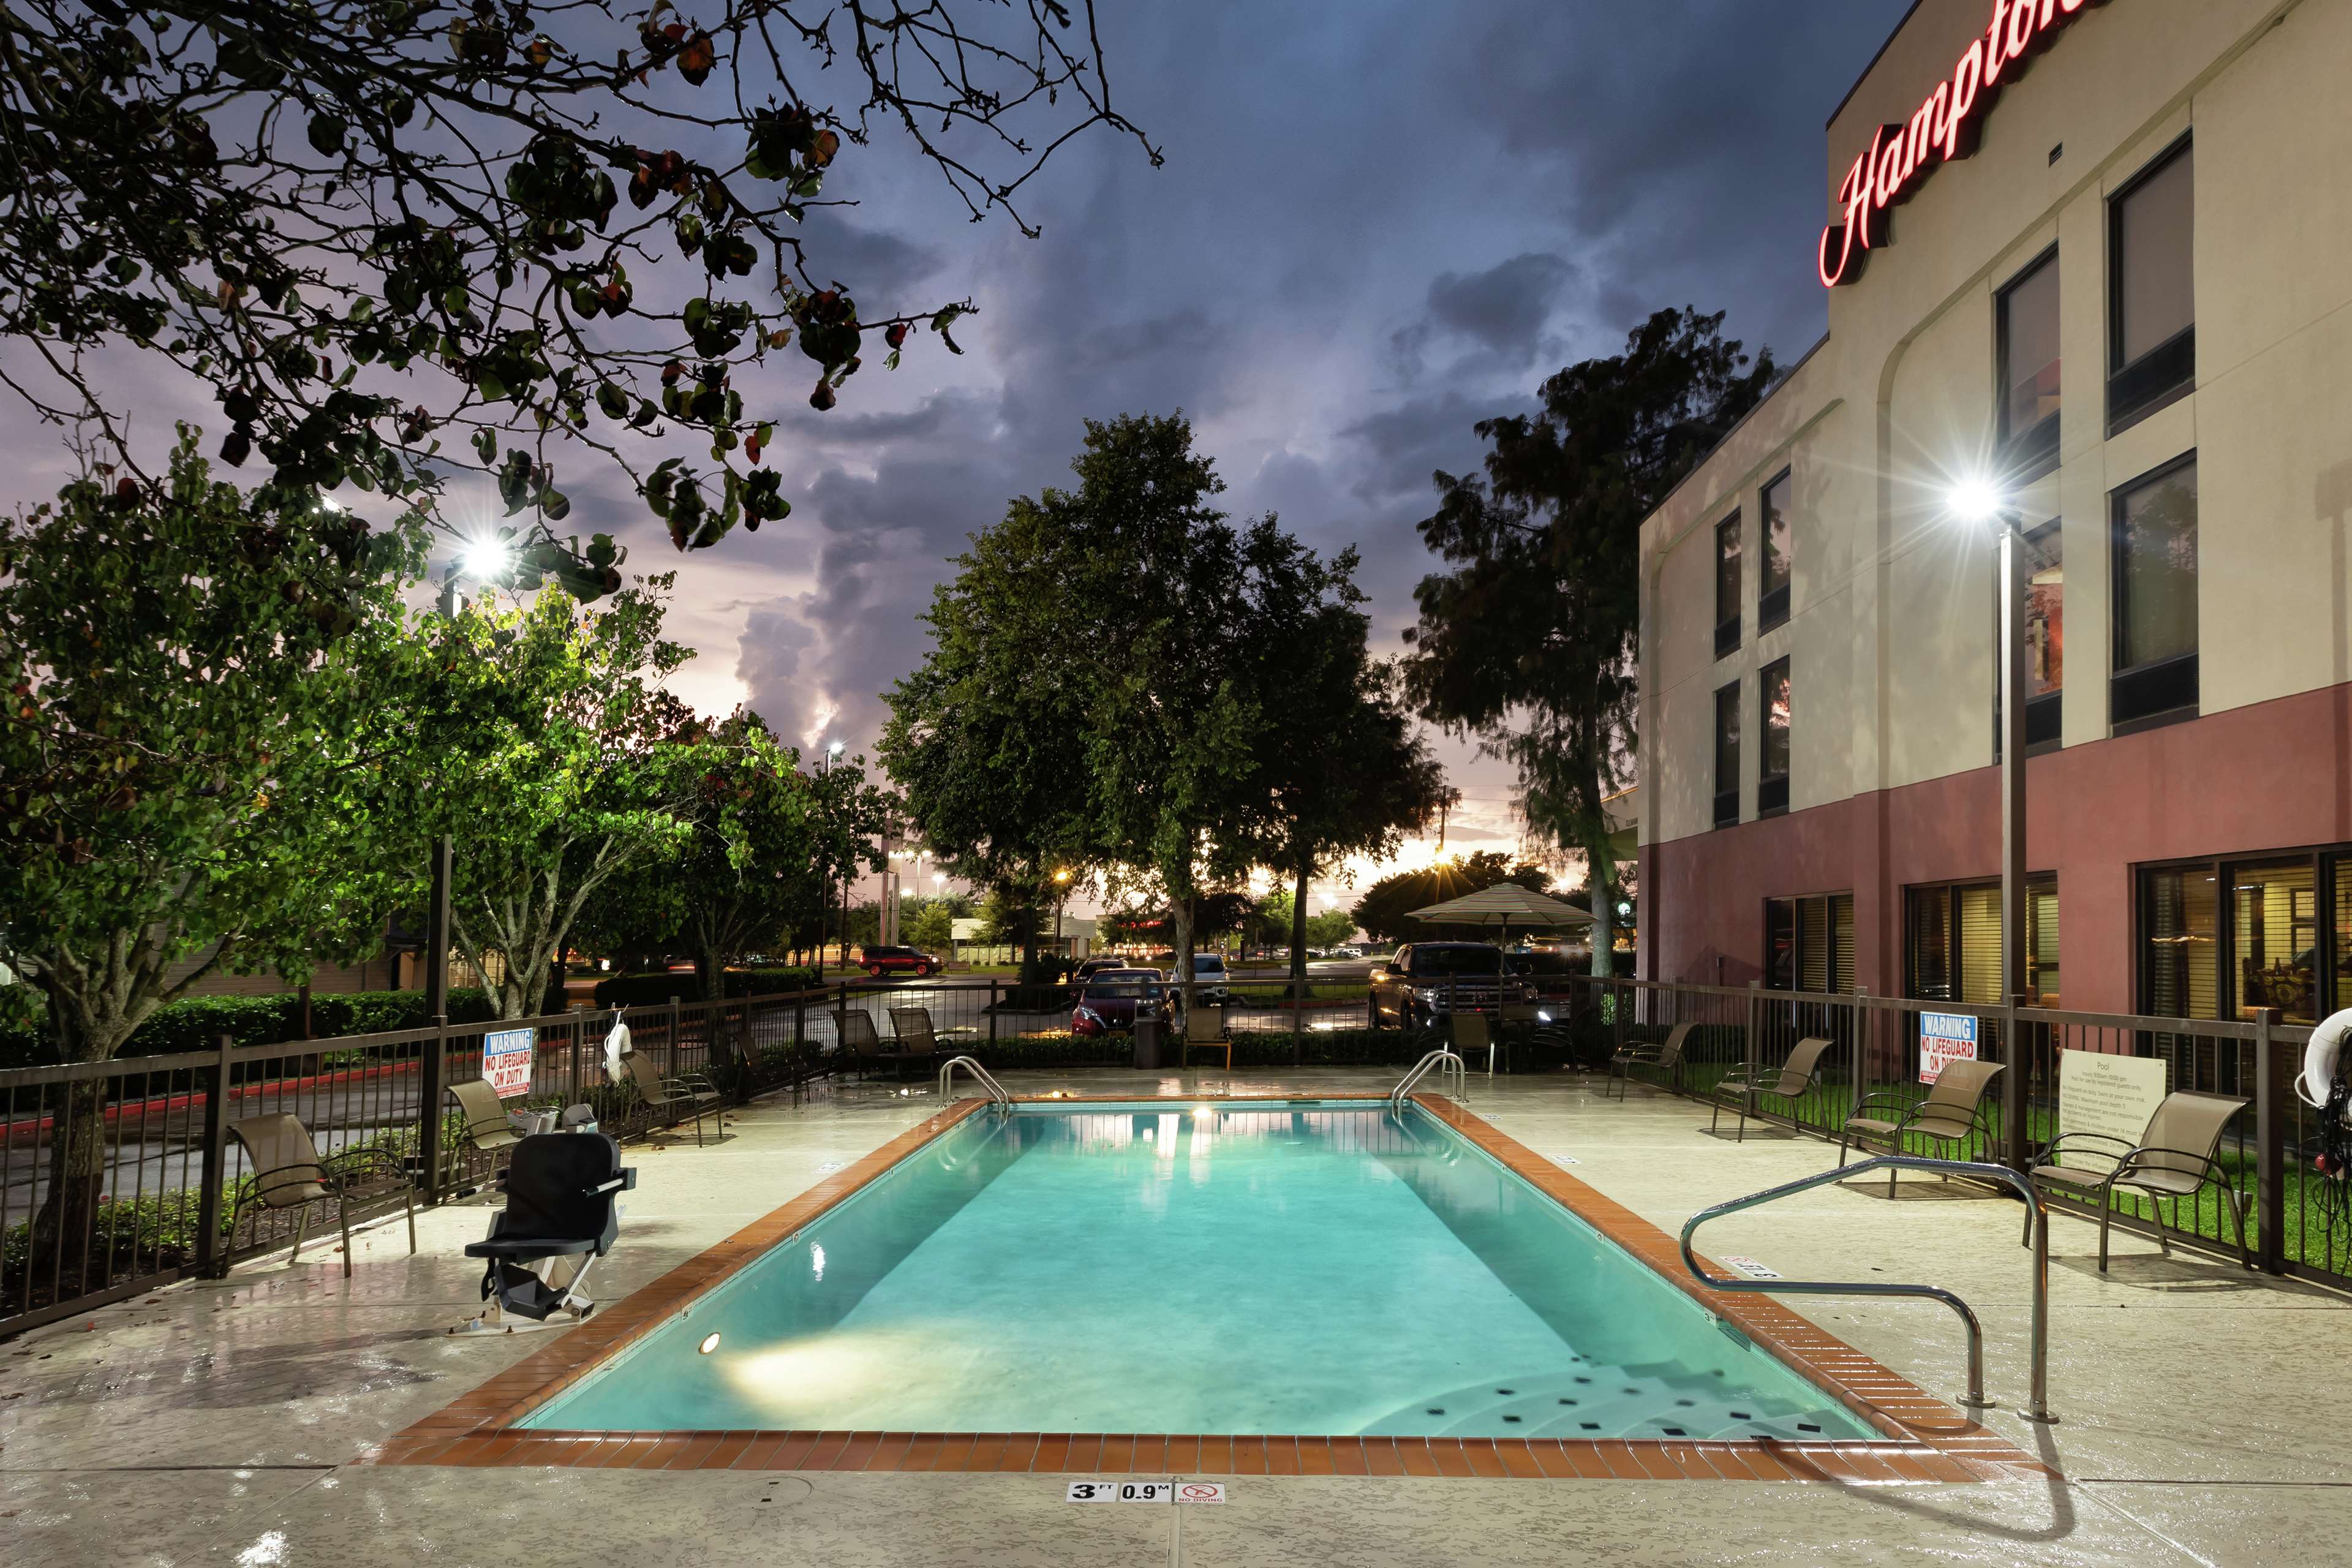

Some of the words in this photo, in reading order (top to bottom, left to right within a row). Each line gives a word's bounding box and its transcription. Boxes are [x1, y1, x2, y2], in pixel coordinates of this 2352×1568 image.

[1924, 1015, 1970, 1039] WARNING
[491, 1031, 530, 1054] WARNING
[1922, 1036, 1930, 1052] NO
[1932, 1038, 1973, 1058] LIFEGUARD
[485, 1055, 496, 1072] NO
[499, 1050, 530, 1069] LIFEGUARD
[1930, 1055, 1939, 1071] ON
[2097, 1061, 2109, 1071] Pool
[494, 1071, 503, 1087] ON
[507, 1068, 523, 1084] DUTY
[1705, 1313, 1710, 1322] 3
[1072, 1484, 1095, 1499] 3
[1122, 1485, 1156, 1499] 0.9
